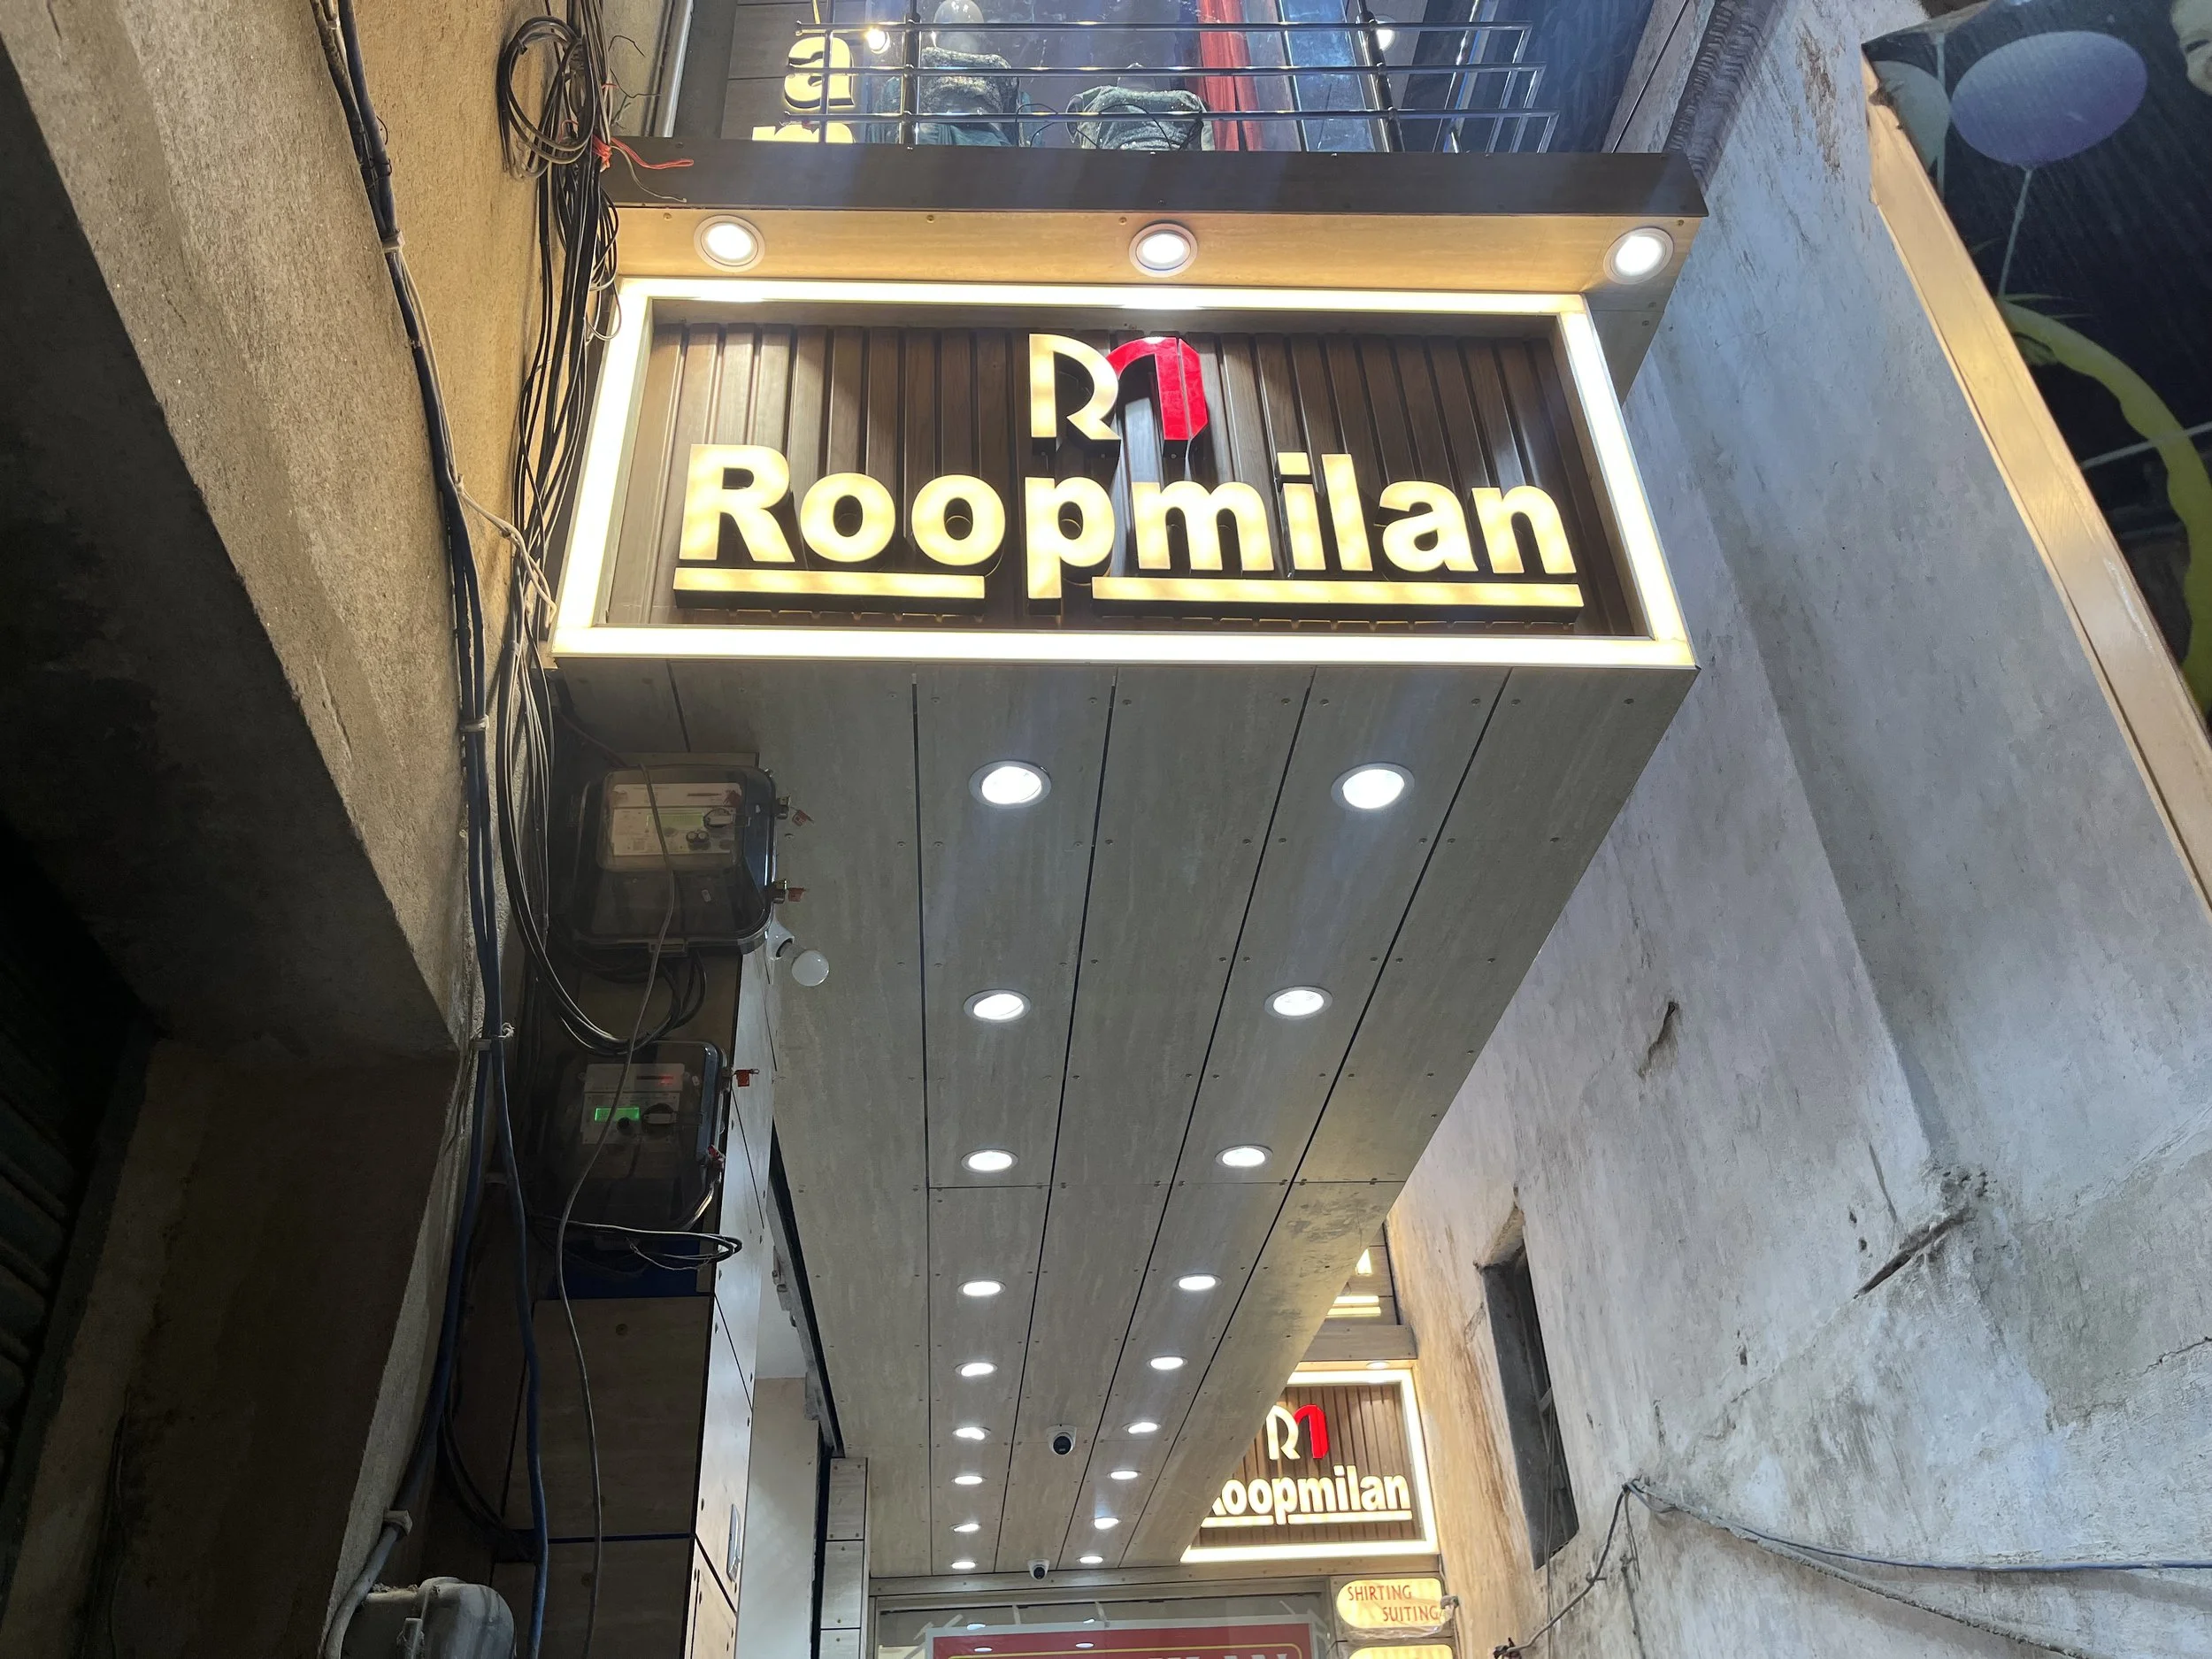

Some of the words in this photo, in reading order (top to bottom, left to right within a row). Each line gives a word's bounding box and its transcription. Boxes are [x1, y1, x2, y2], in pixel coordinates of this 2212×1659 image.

[676, 442, 1578, 602] Roopmilan
[1211, 1464, 1411, 1525] oopmilan
[1347, 1584, 1413, 1601] SHIRTING
[1382, 1605, 1440, 1622] SUITING
